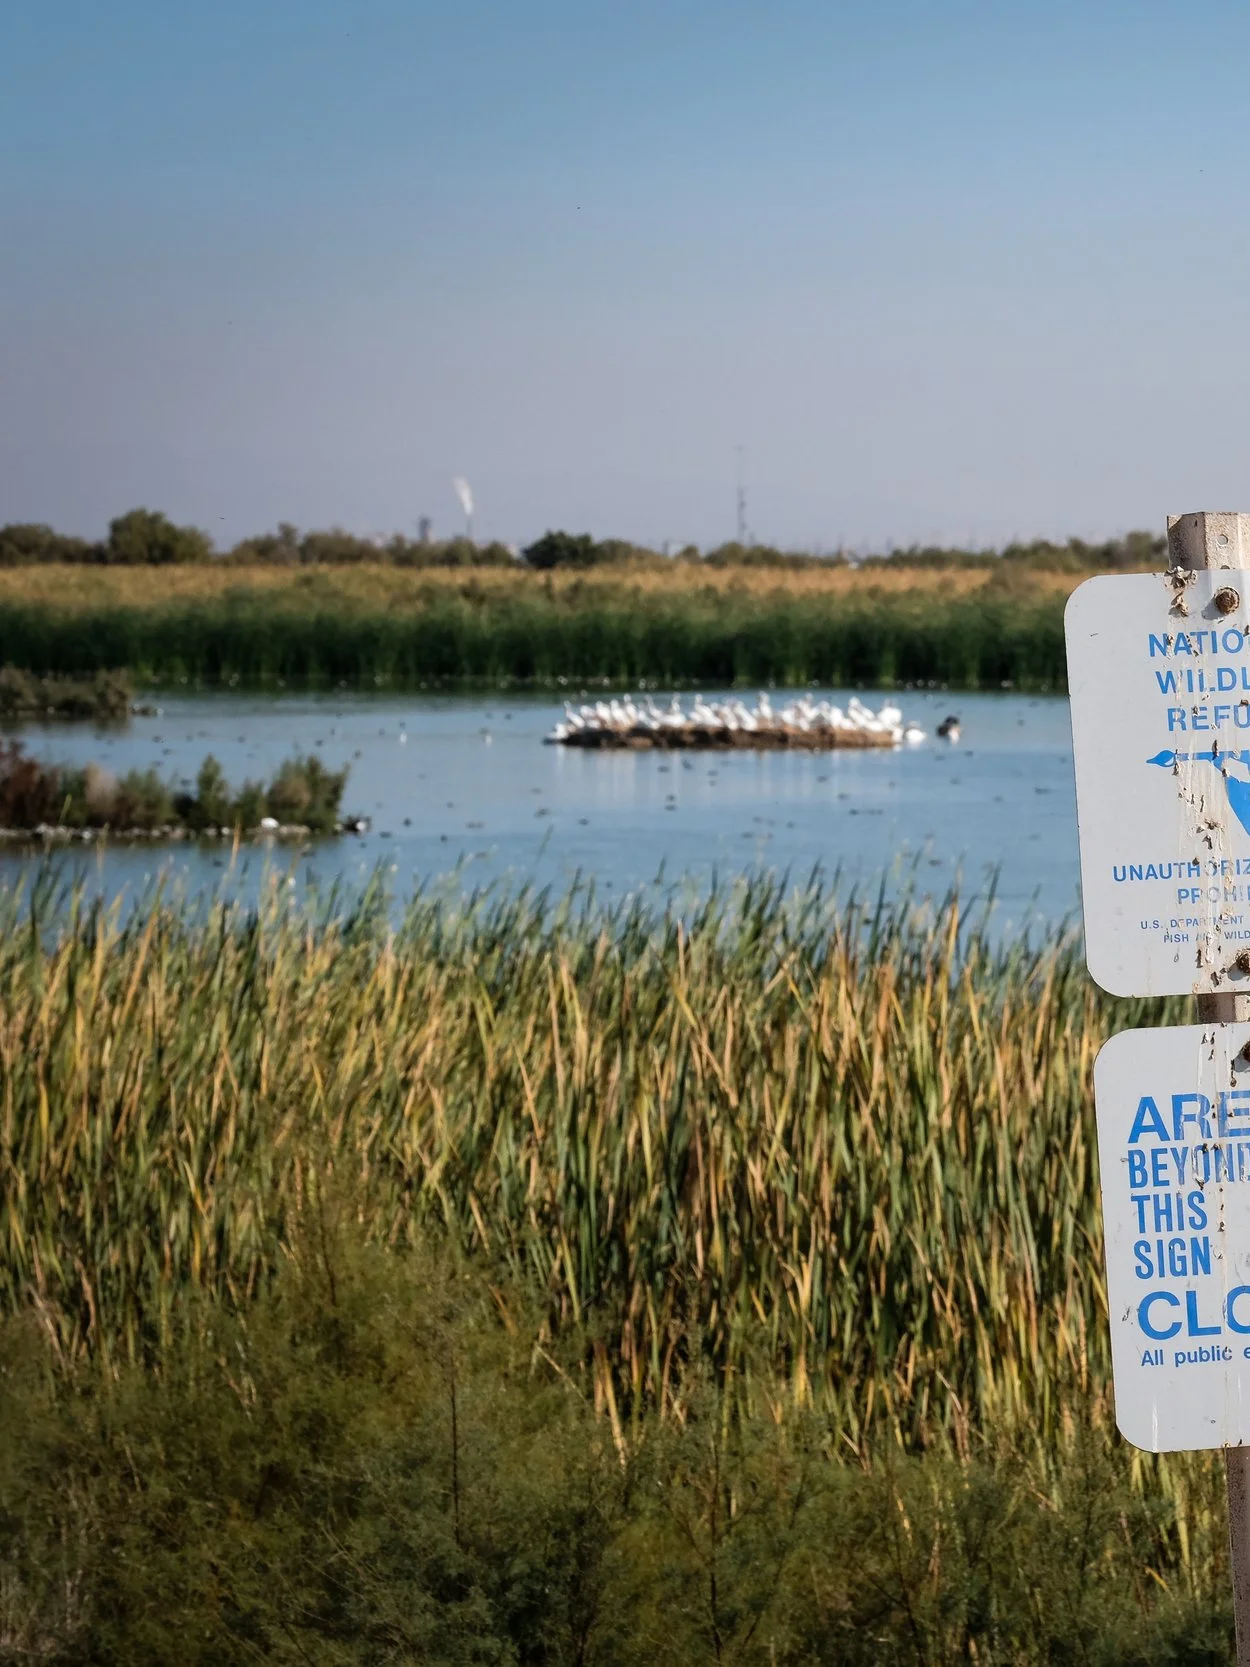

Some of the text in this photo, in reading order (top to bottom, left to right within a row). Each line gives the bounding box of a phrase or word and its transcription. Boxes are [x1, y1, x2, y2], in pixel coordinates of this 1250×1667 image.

[1140, 919, 1163, 929] U.S.
[1130, 1190, 1208, 1234] THIS
[1133, 1236, 1211, 1280] SIGN
[1141, 1349, 1164, 1366] All
[1174, 1345, 1233, 1367] public
